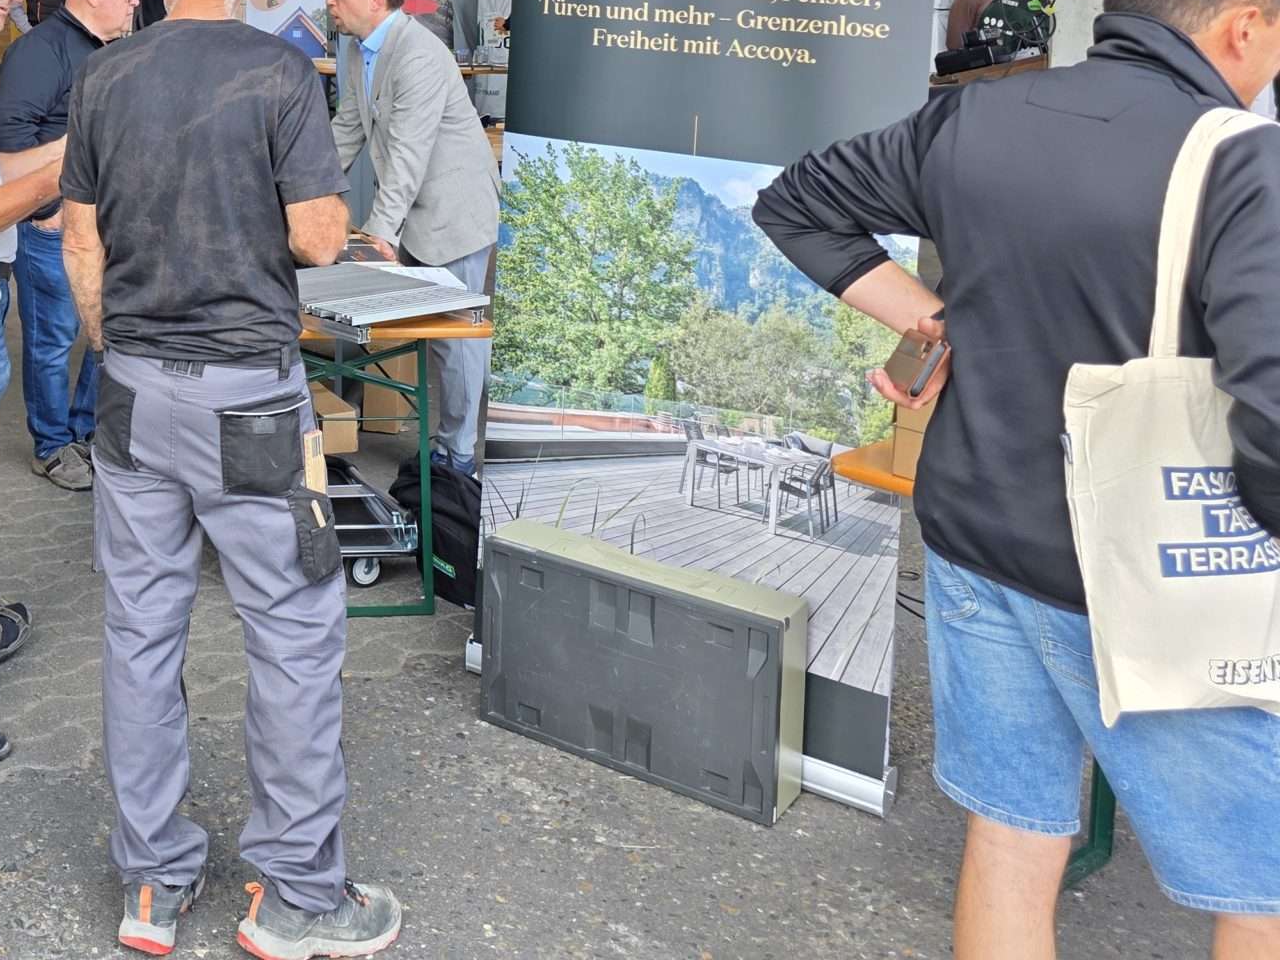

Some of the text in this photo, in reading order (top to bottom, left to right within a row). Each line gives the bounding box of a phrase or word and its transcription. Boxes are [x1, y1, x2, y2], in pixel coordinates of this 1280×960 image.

[606, 2, 649, 22] und
[654, 5, 715, 26] mehr
[736, 9, 891, 39] Grenzenlose
[592, 28, 817, 67] Freiheit mit Accoya.
